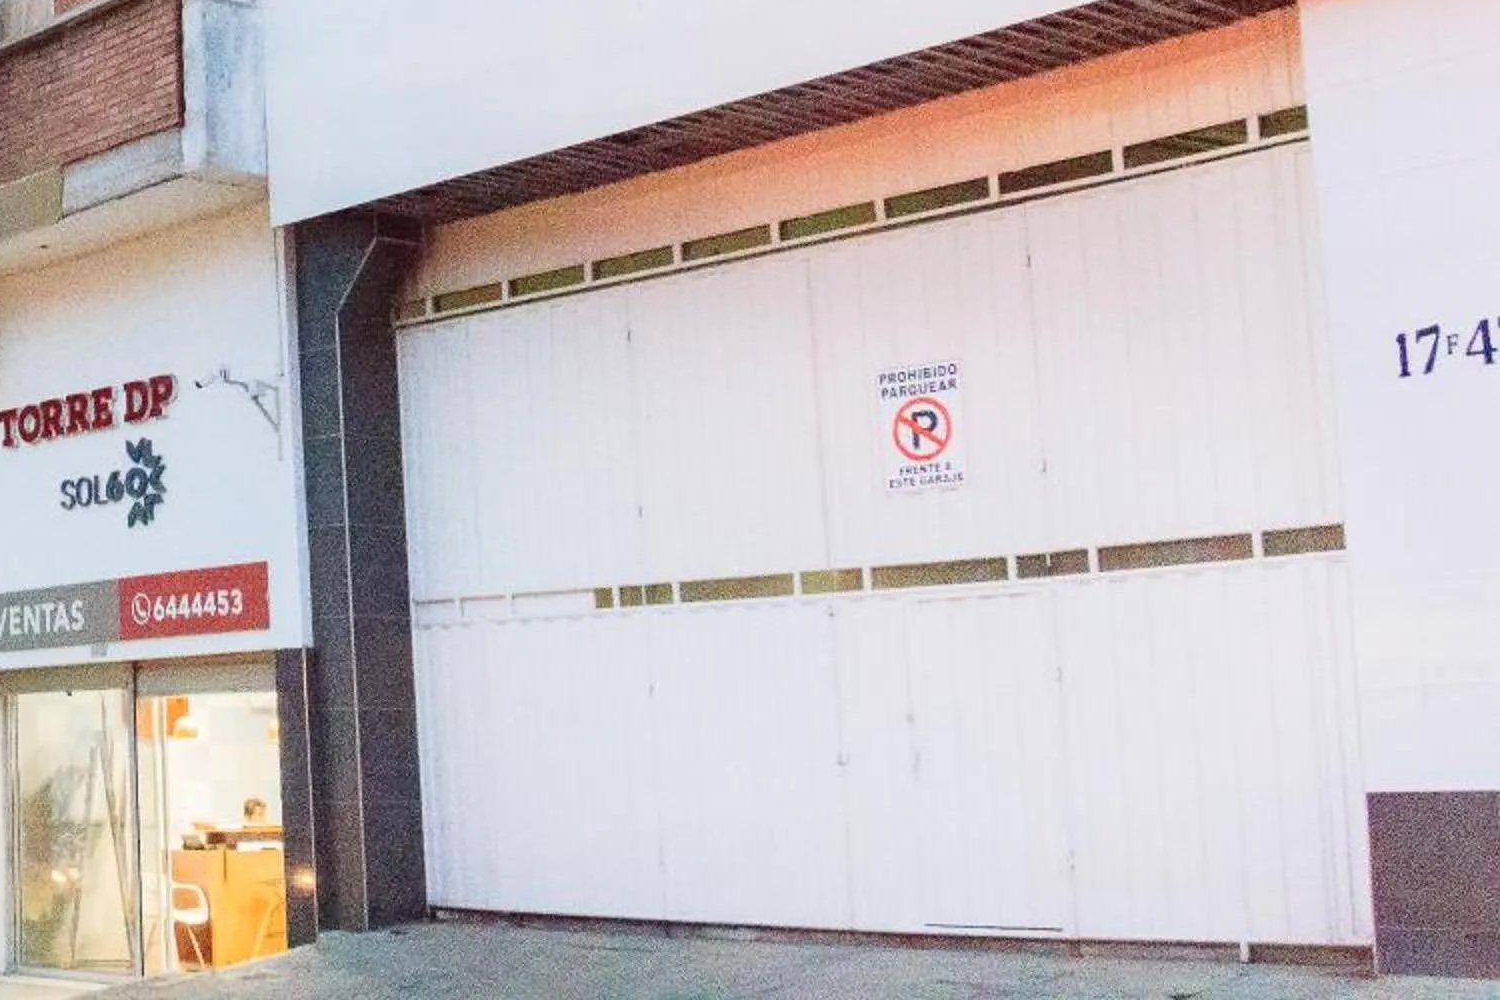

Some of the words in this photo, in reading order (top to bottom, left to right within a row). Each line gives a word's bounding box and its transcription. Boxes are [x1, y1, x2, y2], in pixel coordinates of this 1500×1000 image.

[1396, 315, 1500, 378] 17F4
[878, 363, 958, 386] PROHIBIDO
[123, 374, 177, 423] DP
[881, 378, 958, 399] PARQUEAR
[889, 476, 916, 489] ESTE
[919, 471, 965, 486] GARAJE
[899, 463, 940, 476] FRENTE
[153, 588, 244, 622] 6444453
